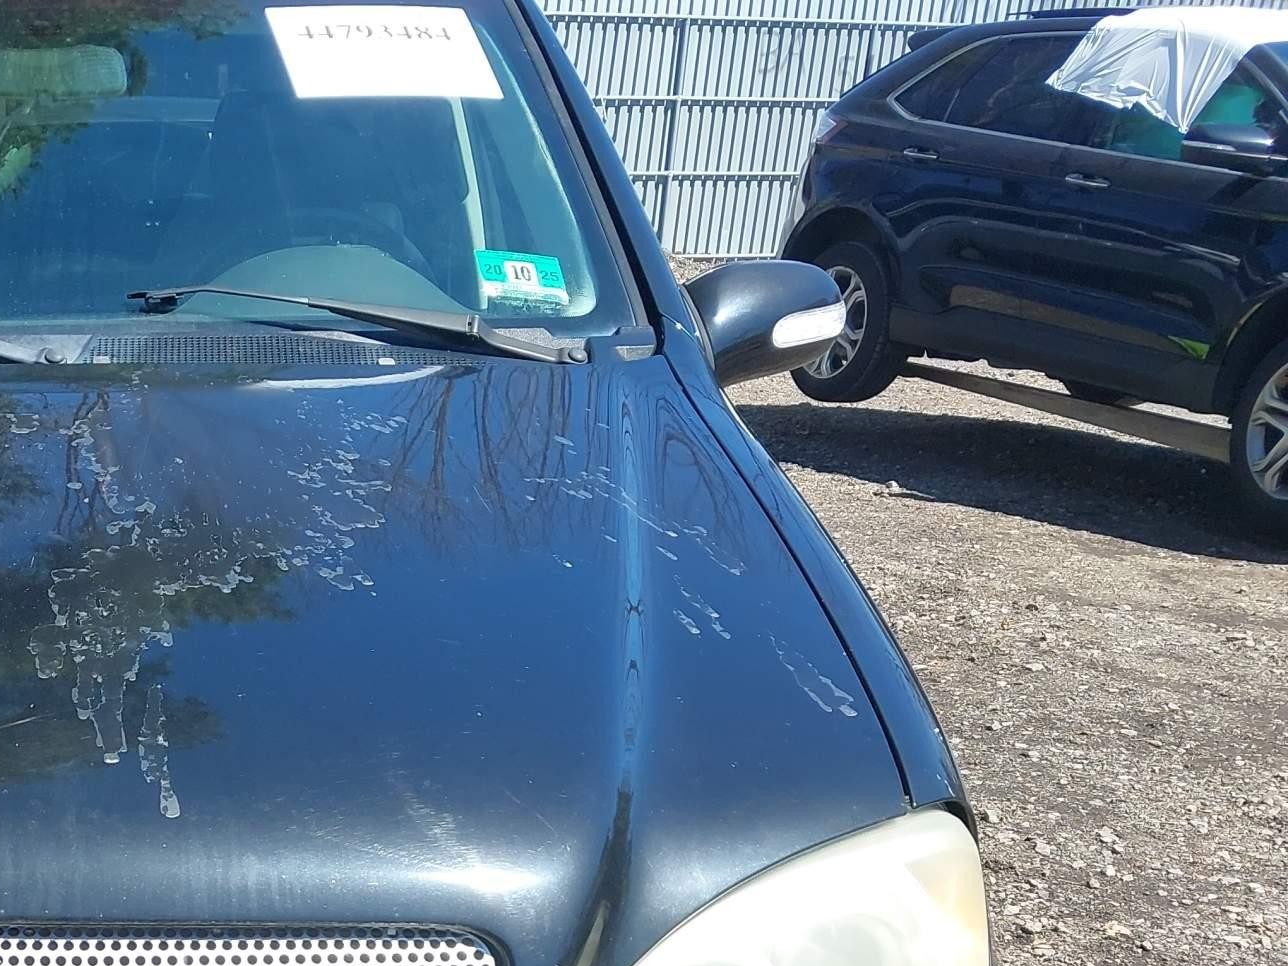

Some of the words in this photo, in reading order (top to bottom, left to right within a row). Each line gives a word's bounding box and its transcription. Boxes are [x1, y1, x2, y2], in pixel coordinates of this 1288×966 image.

[297, 24, 451, 40] 44793484
[484, 263, 502, 275] 20
[512, 265, 531, 281] 10
[540, 270, 560, 281] 25
